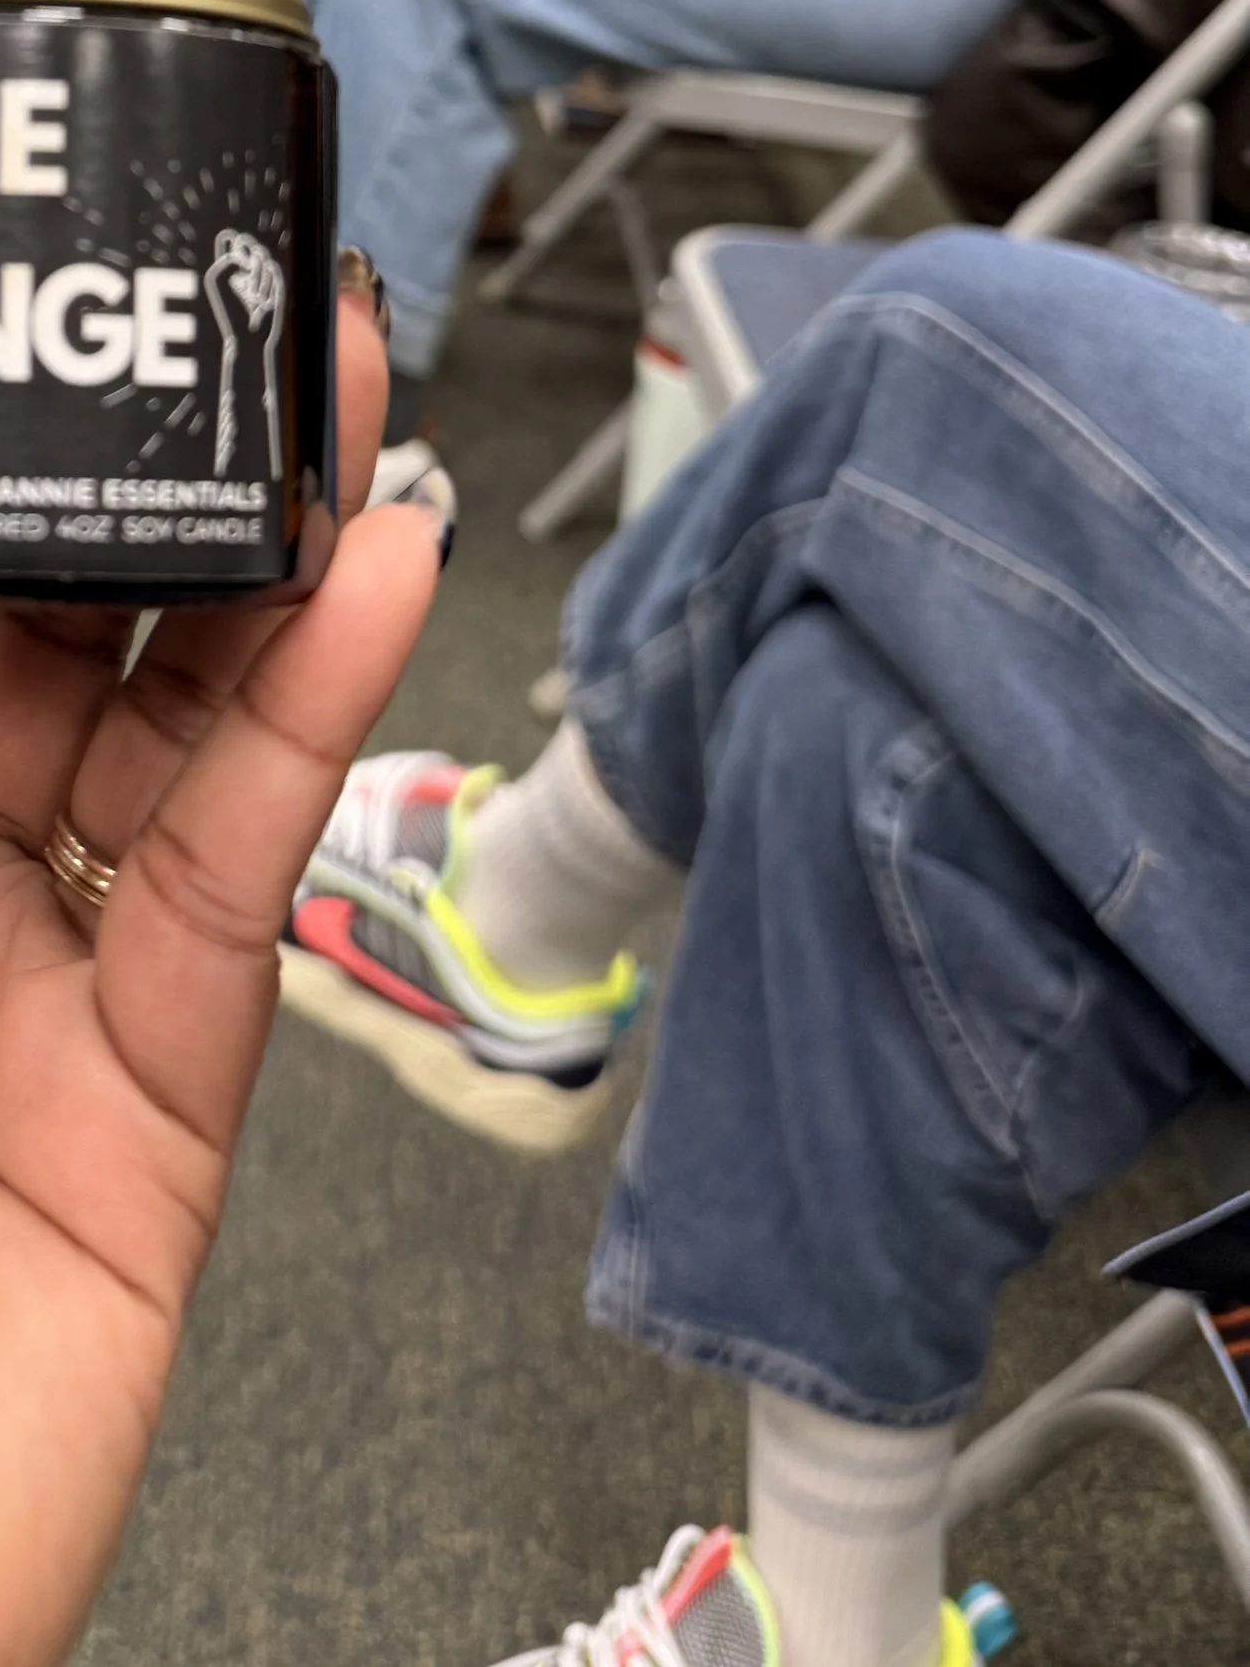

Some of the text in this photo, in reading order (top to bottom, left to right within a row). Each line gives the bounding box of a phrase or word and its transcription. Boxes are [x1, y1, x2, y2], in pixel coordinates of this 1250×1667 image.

[102, 478, 268, 512] ESSENTIALS
[120, 515, 172, 544] SOY
[175, 516, 264, 545] CANDLE
